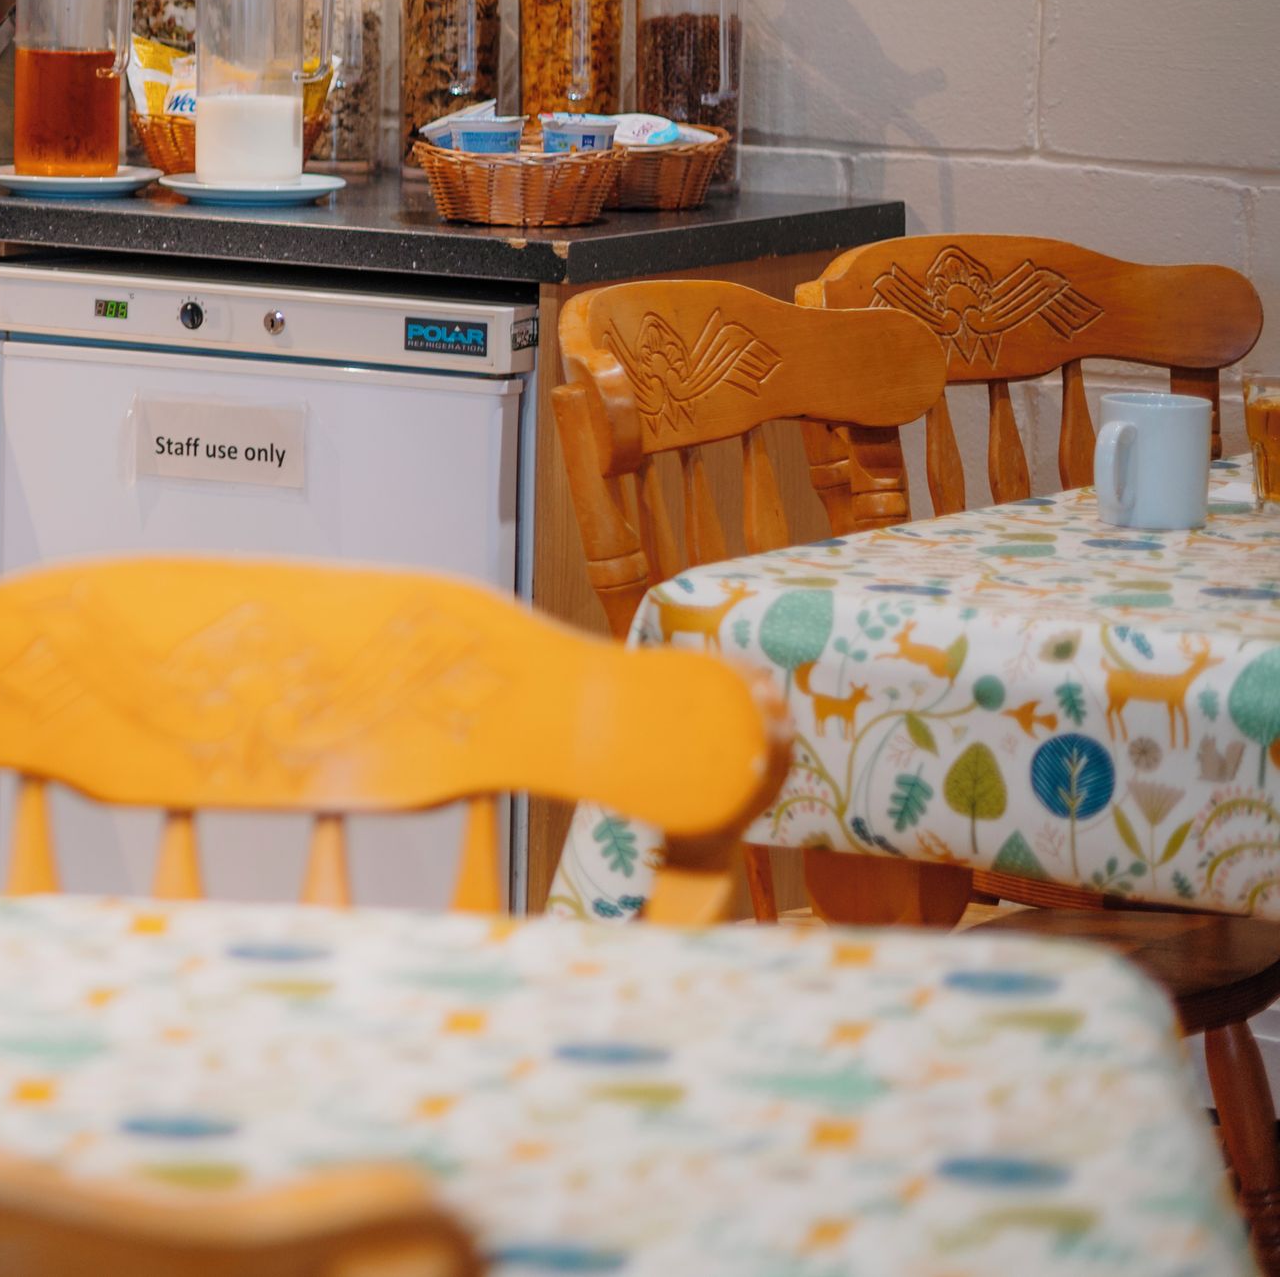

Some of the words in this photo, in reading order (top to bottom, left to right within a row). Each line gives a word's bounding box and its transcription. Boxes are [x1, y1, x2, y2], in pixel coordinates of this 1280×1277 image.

[407, 324, 484, 346] POLAR
[408, 340, 484, 352] REFRIGERATION
[155, 436, 200, 457] Staff
[206, 444, 238, 460] use
[244, 443, 286, 468] only
